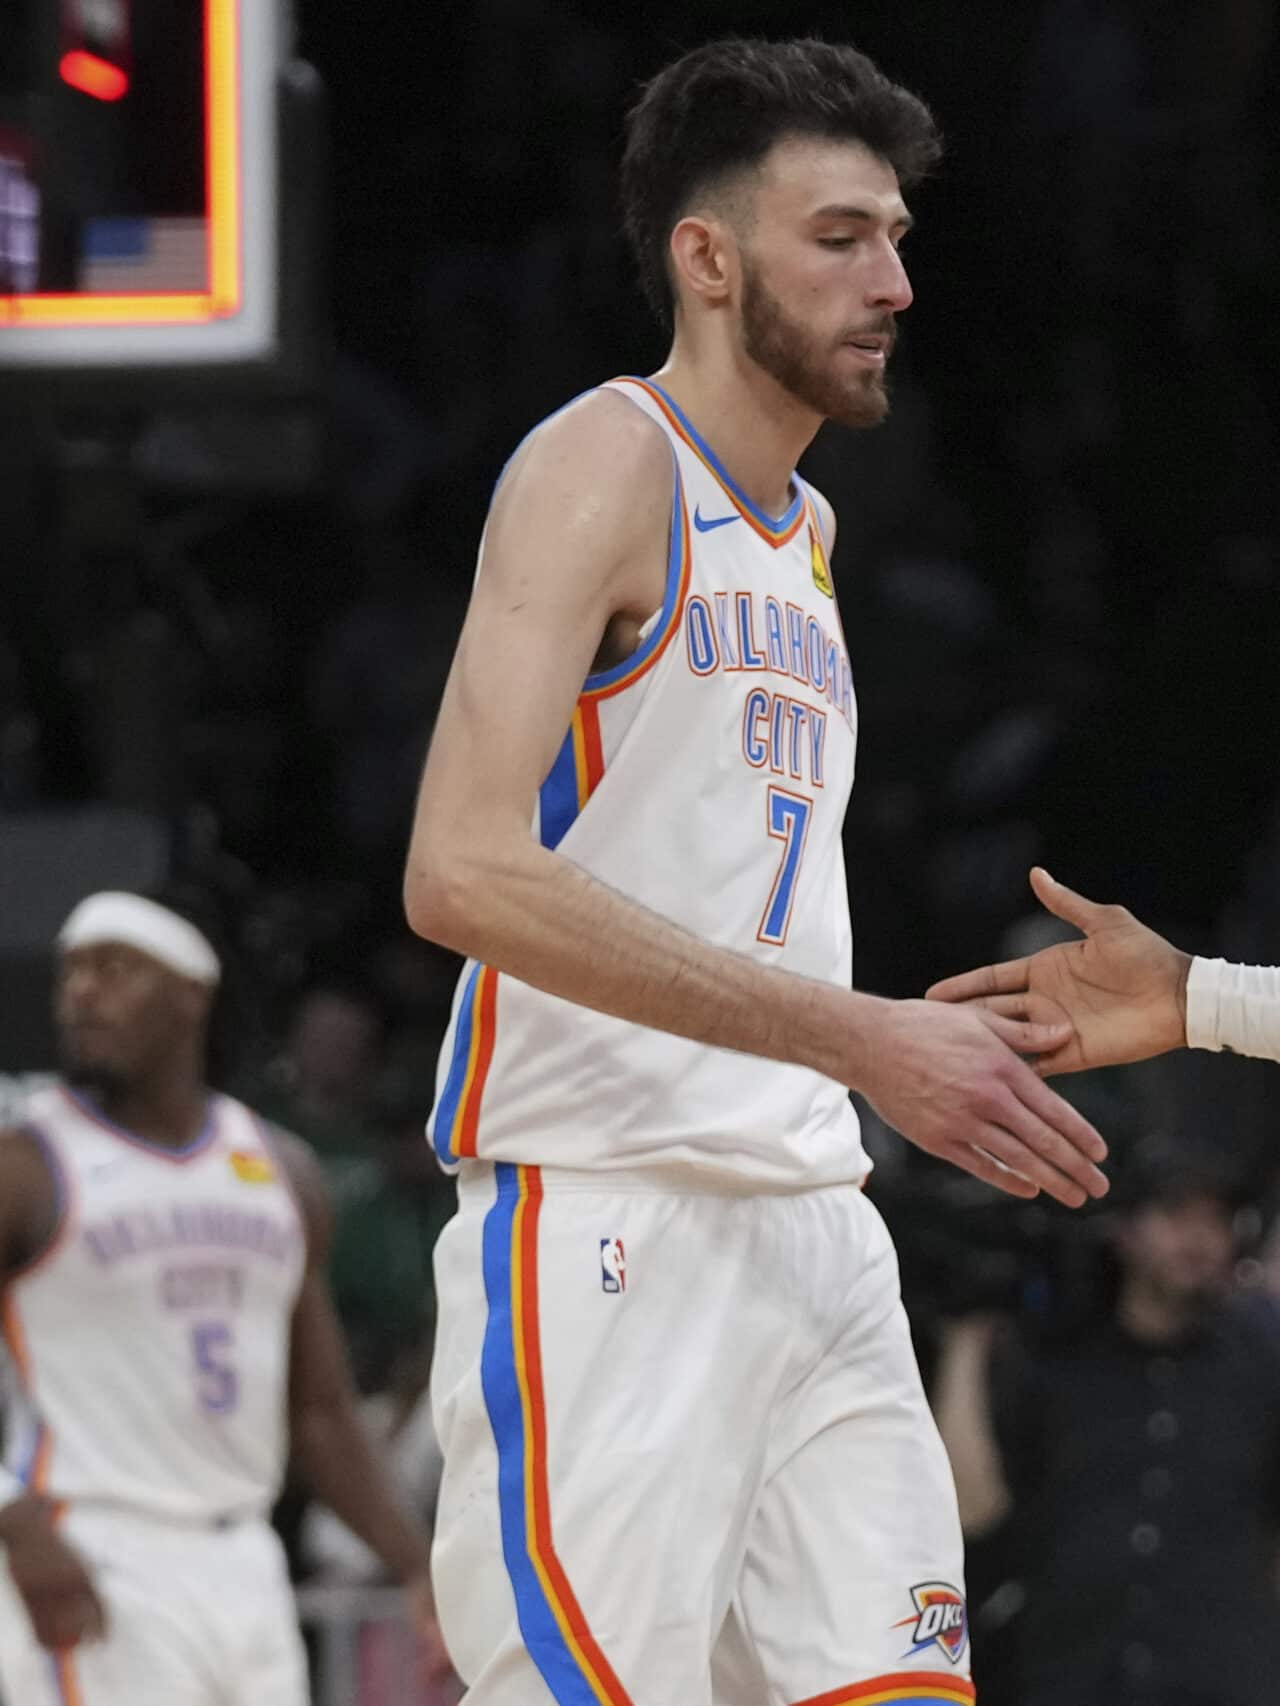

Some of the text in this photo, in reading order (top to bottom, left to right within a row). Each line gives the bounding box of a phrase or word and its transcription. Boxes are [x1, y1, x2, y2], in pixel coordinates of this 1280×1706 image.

[742, 687, 827, 788] CITY
[756, 784, 814, 948] 7
[190, 1317, 240, 1415] 5
